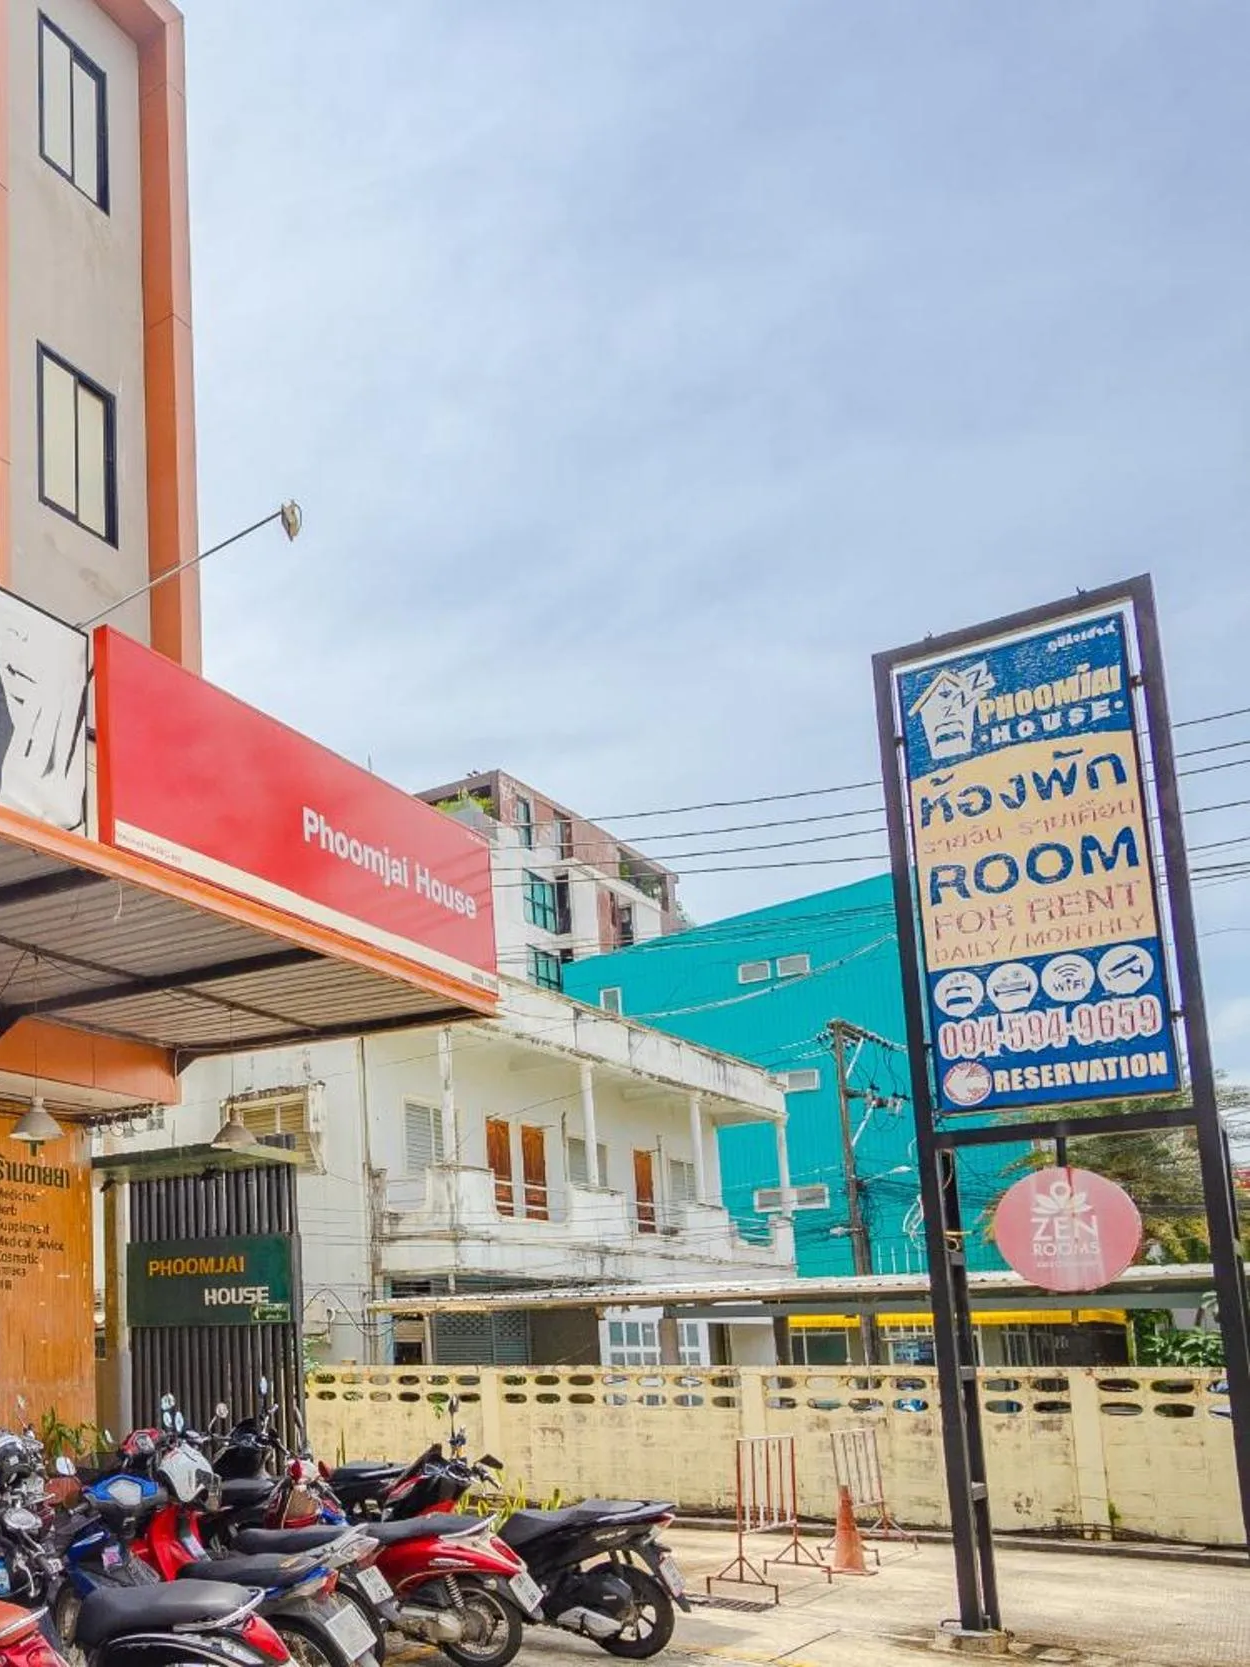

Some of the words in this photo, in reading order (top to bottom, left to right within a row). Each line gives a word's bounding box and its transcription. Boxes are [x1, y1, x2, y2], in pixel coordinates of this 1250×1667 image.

[920, 748, 1128, 829] ห้องพัก
[302, 805, 409, 889] Phoomjai
[415, 862, 477, 920] House
[930, 826, 1139, 905] ROOM
[934, 903, 1015, 941] FOR
[1027, 879, 1141, 921] RENT
[993, 1051, 1168, 1092] RESERVATION
[1030, 1214, 1099, 1241] ZEN
[149, 1256, 245, 1277] PHOOMJAI
[1033, 1241, 1100, 1257] ROOMS
[204, 1286, 269, 1306] HOUSE
